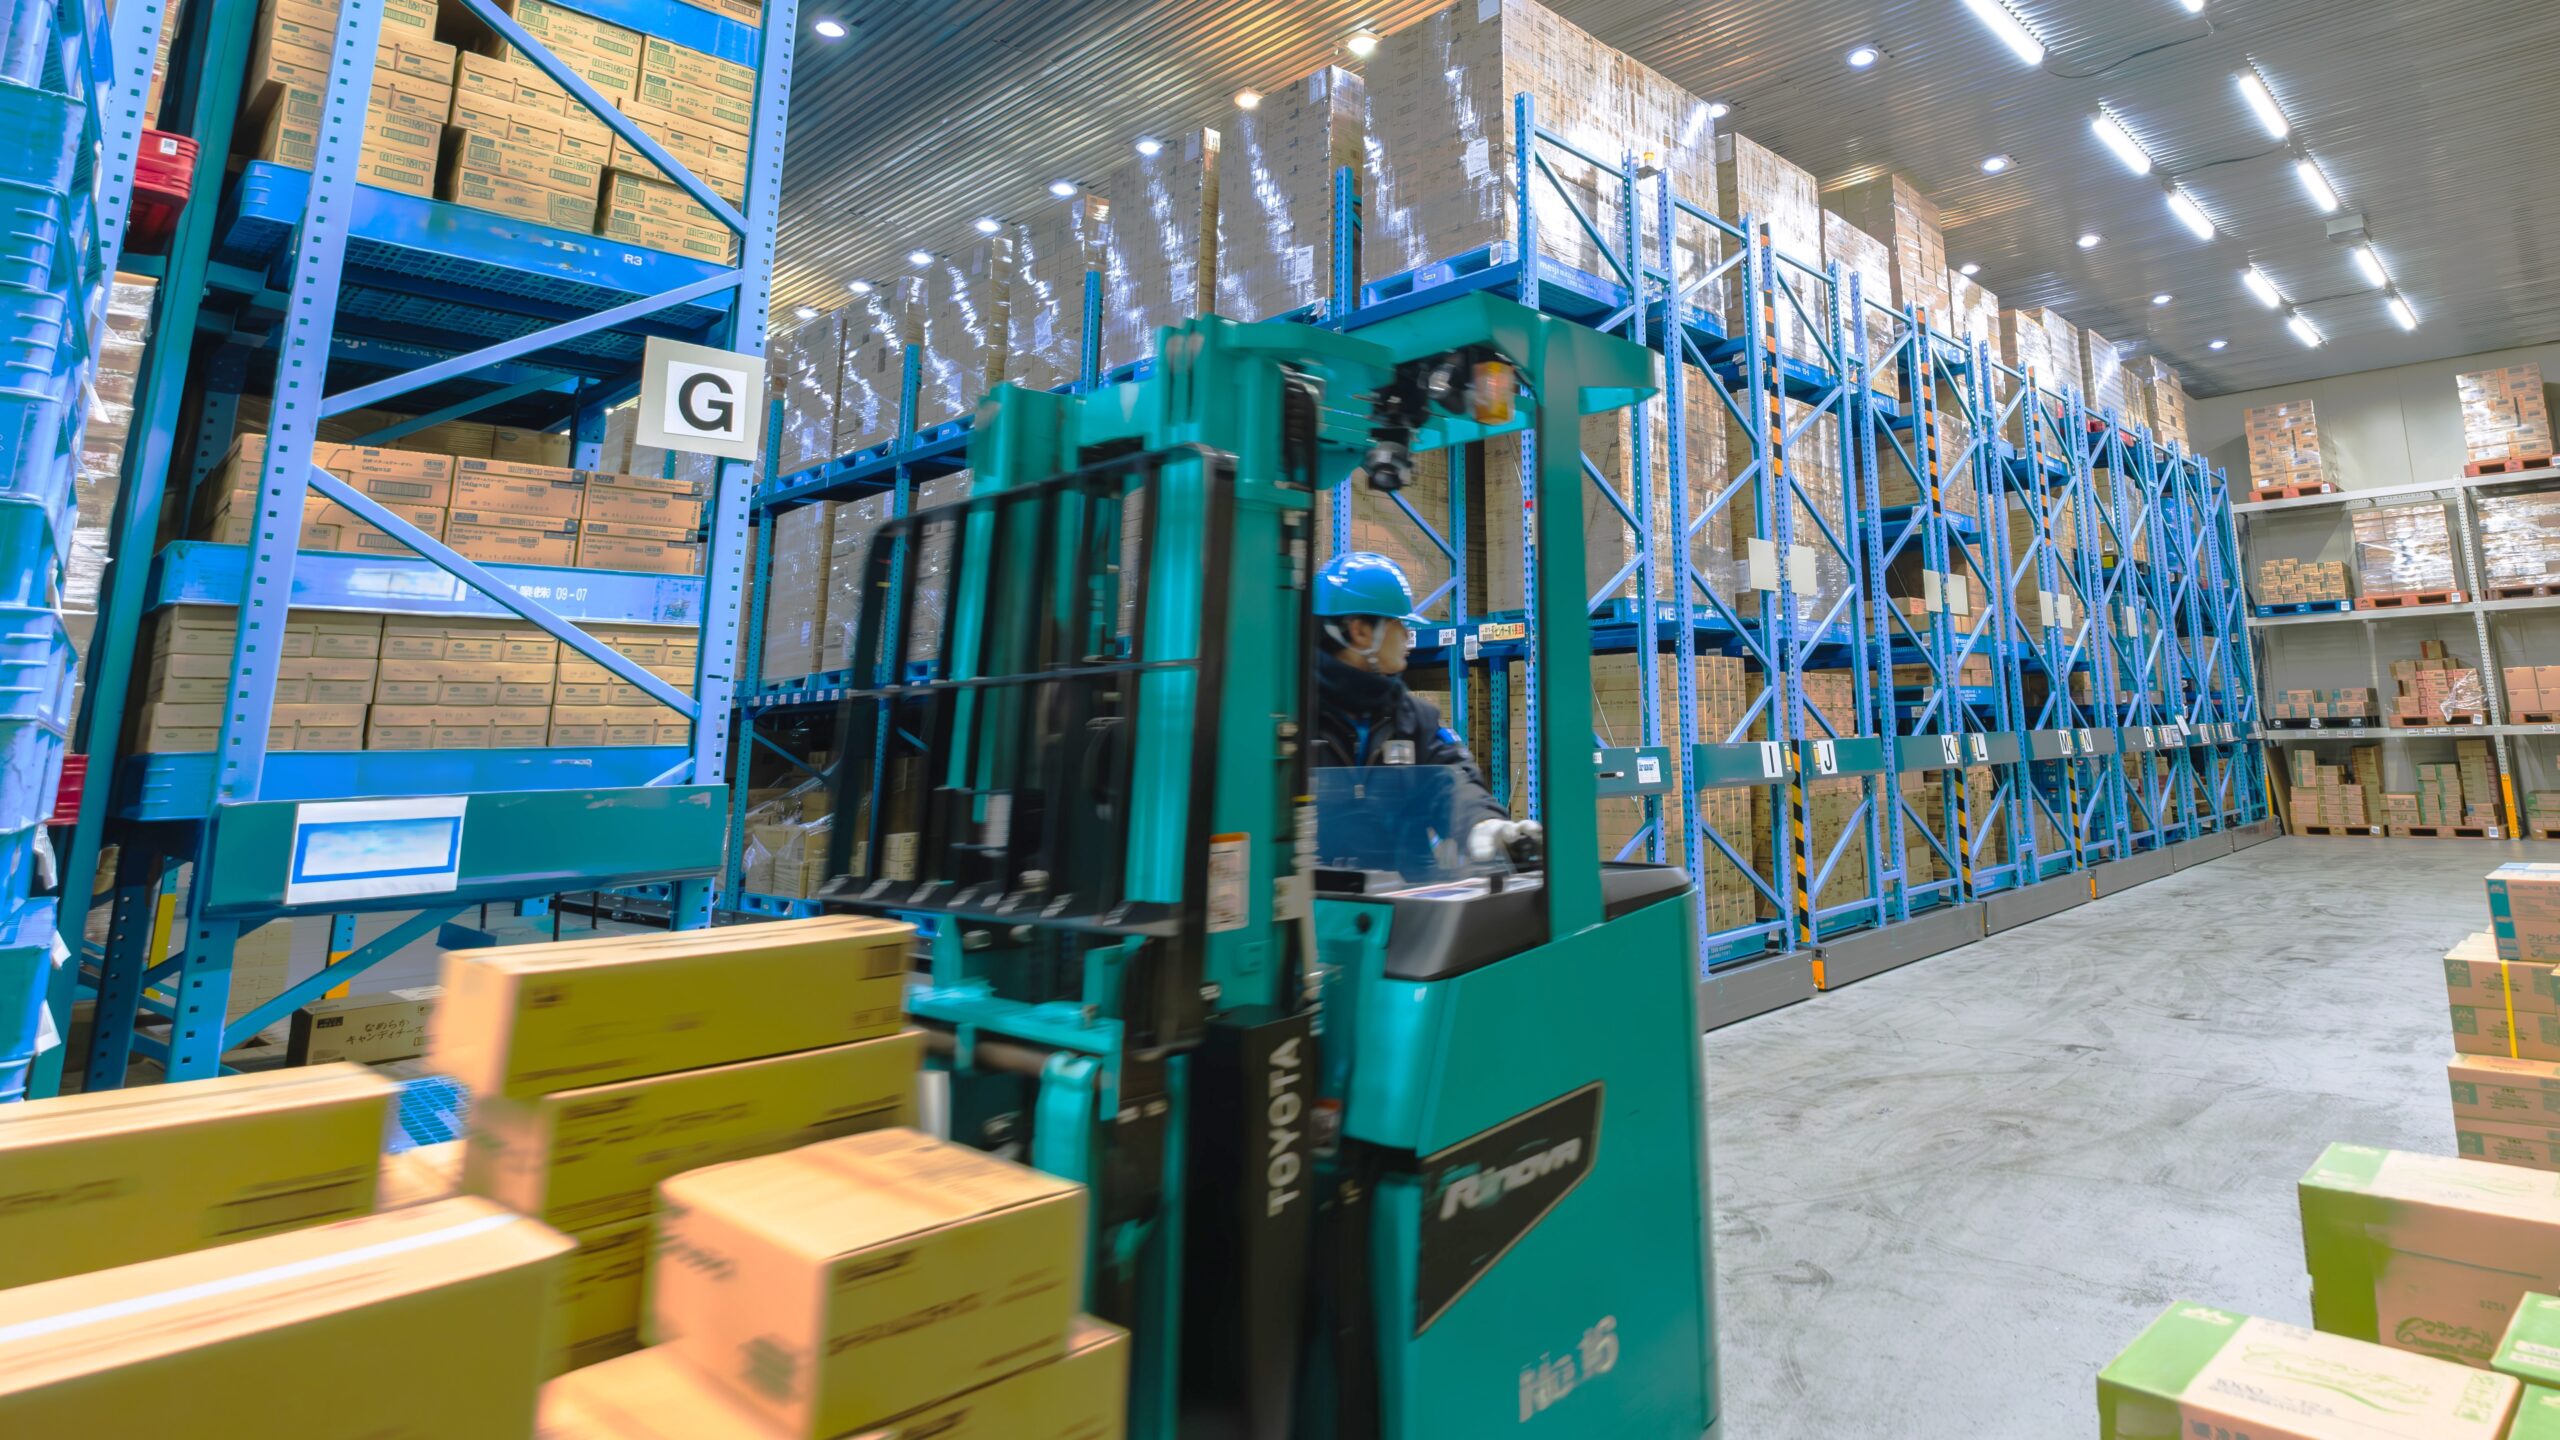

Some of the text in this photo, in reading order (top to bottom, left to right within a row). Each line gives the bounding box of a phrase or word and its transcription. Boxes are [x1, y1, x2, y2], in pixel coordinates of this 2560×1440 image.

[623, 254, 643, 266] R3
[678, 373, 735, 433] G
[555, 586, 588, 601] 09-07
[1944, 737, 1955, 761] K
[1975, 736, 1986, 758] L
[2059, 731, 2070, 752] M
[2083, 730, 2092, 751] N
[1823, 744, 1834, 771] J
[365, 1018, 410, 1033] なめらか
[1267, 1036, 1302, 1218] TOYOTA
